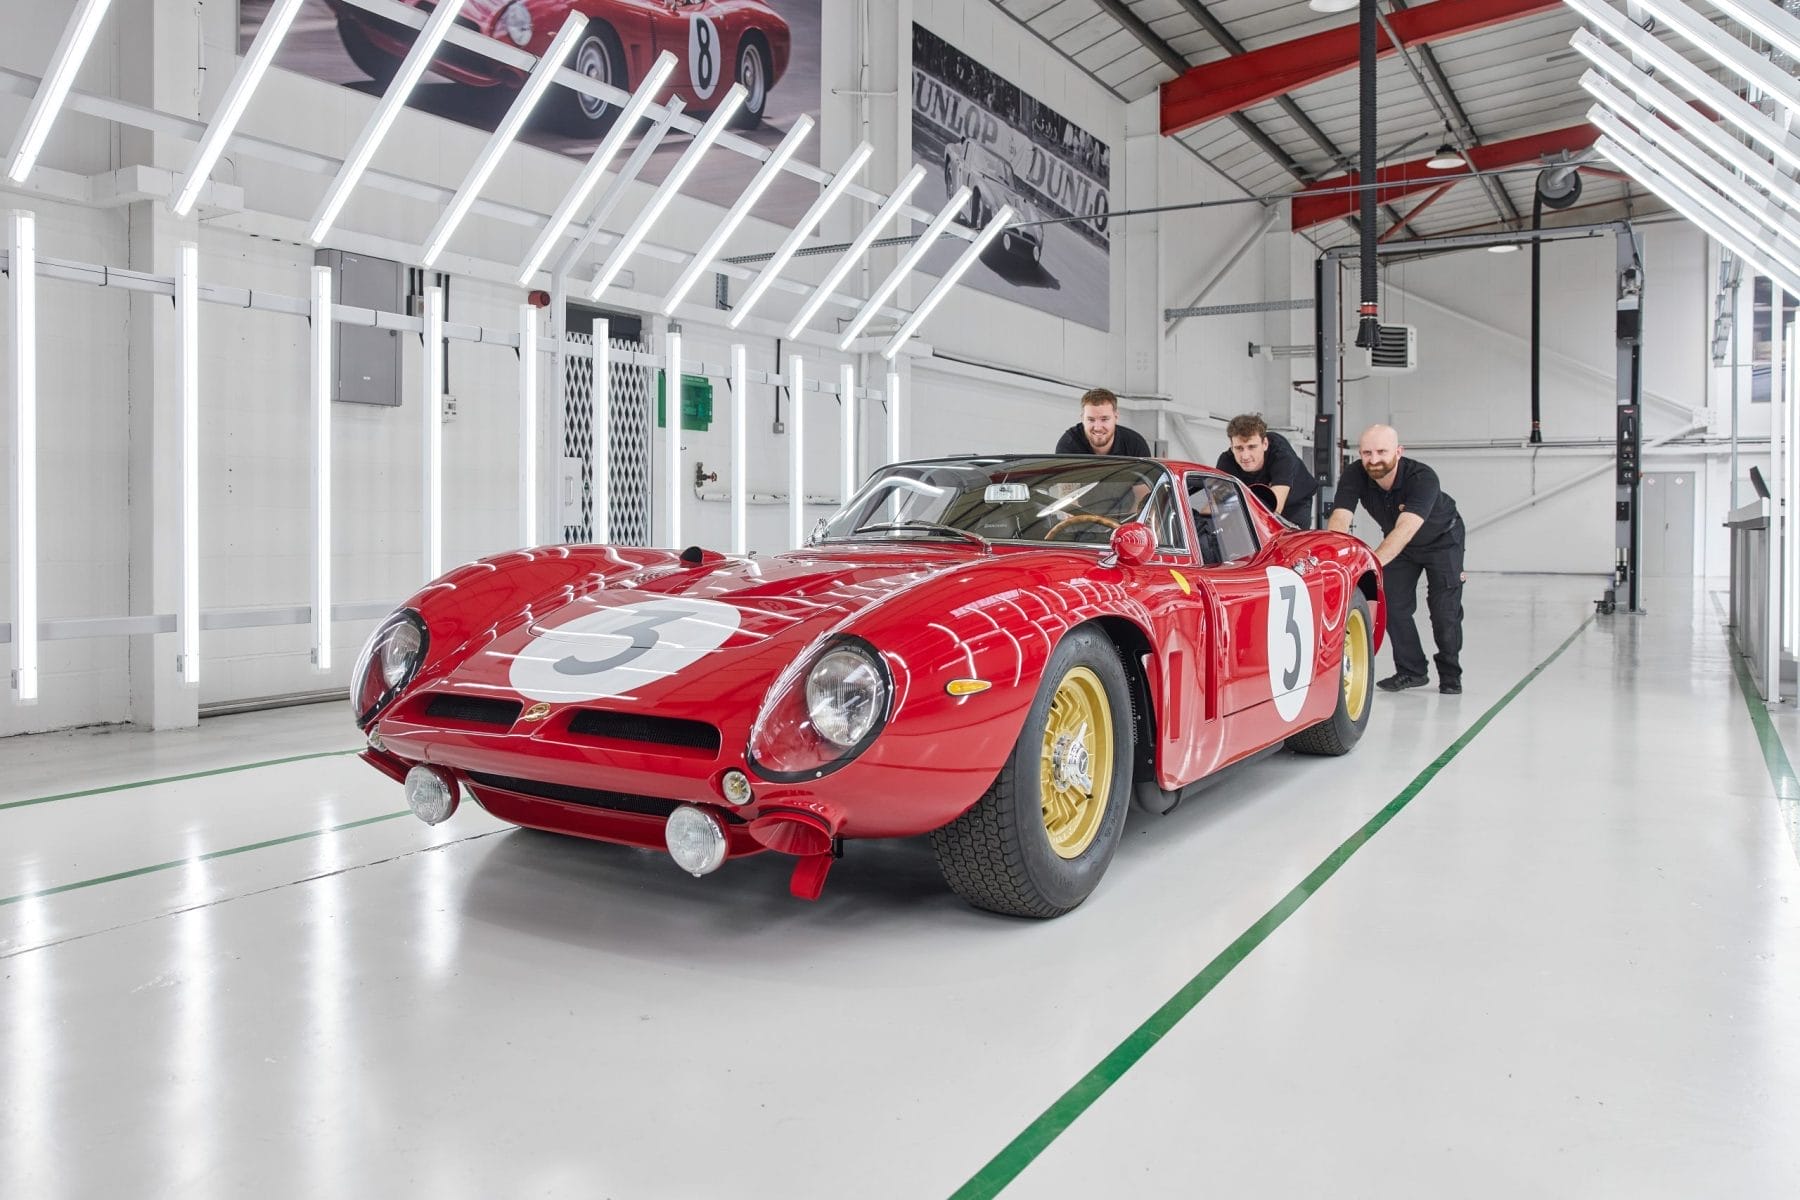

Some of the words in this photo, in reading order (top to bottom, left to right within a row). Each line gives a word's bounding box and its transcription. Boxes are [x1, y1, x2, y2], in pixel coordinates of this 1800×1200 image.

[696, 17, 713, 90] 8
[912, 70, 998, 144] UNLOP
[1026, 146, 1109, 236] DUNLO
[553, 609, 697, 675] 3
[1279, 585, 1302, 690] 3
